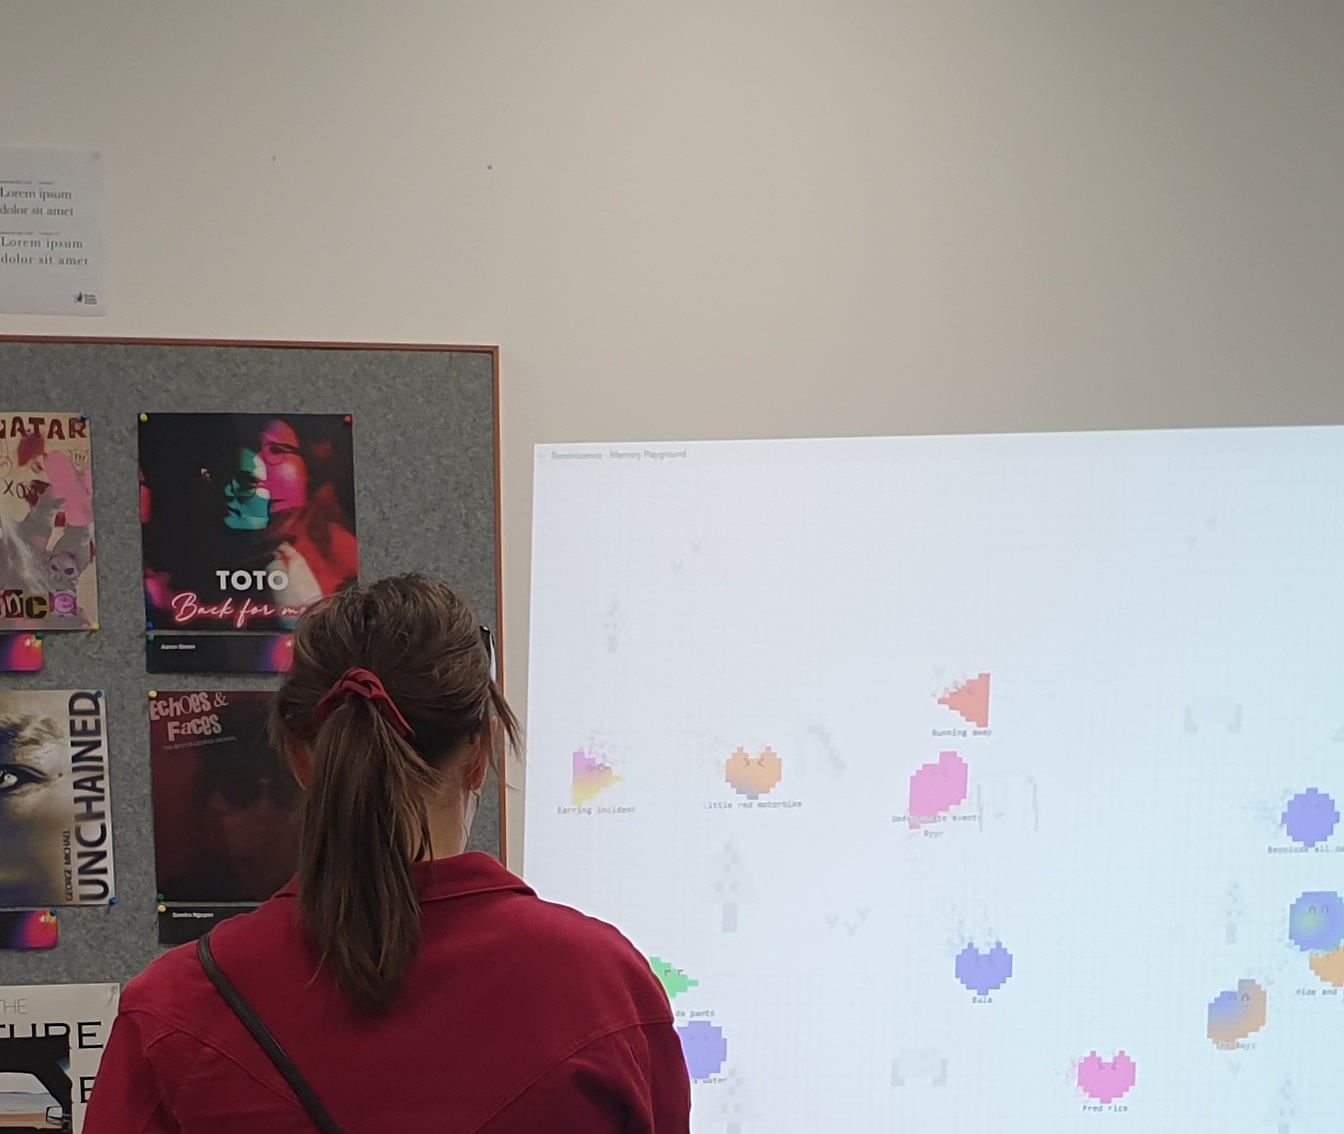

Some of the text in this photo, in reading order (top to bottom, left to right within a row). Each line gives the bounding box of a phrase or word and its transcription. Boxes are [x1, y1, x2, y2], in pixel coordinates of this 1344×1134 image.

[0, 187, 72, 201] Lorem ipsum
[0, 204, 74, 217] dolor sit amet
[1, 236, 84, 251] Lorem ipsum
[0, 253, 89, 266] dolor sit amet
[216, 569, 289, 591] TOTO
[171, 592, 234, 623] Back
[236, 598, 276, 628] for
[213, 692, 229, 707] &
[68, 691, 110, 901] UNCHAINED
[62, 830, 73, 901] GEORGE MICHAEL
